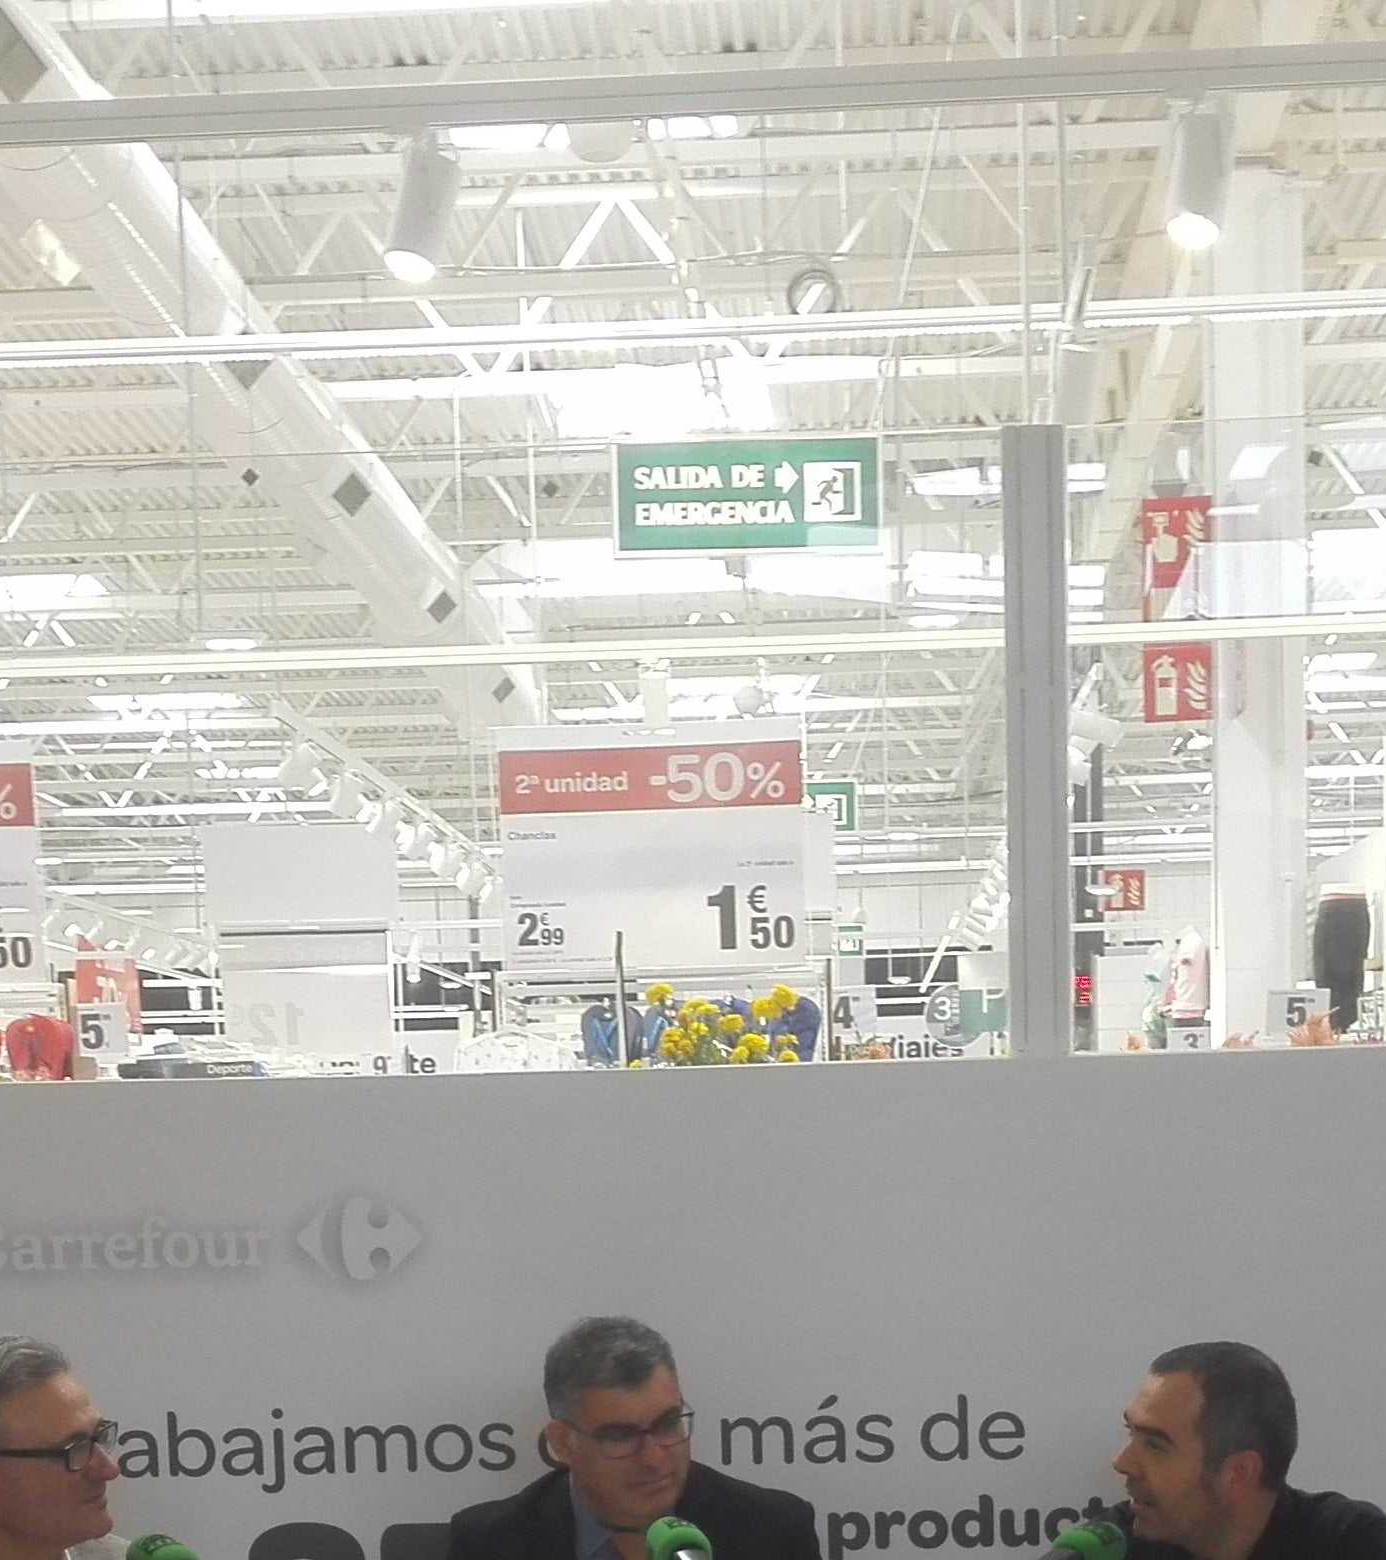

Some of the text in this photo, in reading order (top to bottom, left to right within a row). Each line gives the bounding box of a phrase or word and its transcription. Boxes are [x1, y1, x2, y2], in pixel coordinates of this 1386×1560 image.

[633, 463, 765, 492] SALIDA DE
[634, 499, 795, 528] EMERGENCIA
[544, 770, 629, 794] unidad
[648, 752, 786, 803] -50%
[205, 1062, 253, 1076] Deporte
[116, 1407, 517, 1494] abajamos
[719, 1393, 895, 1466] más
[920, 1393, 1026, 1463] de
